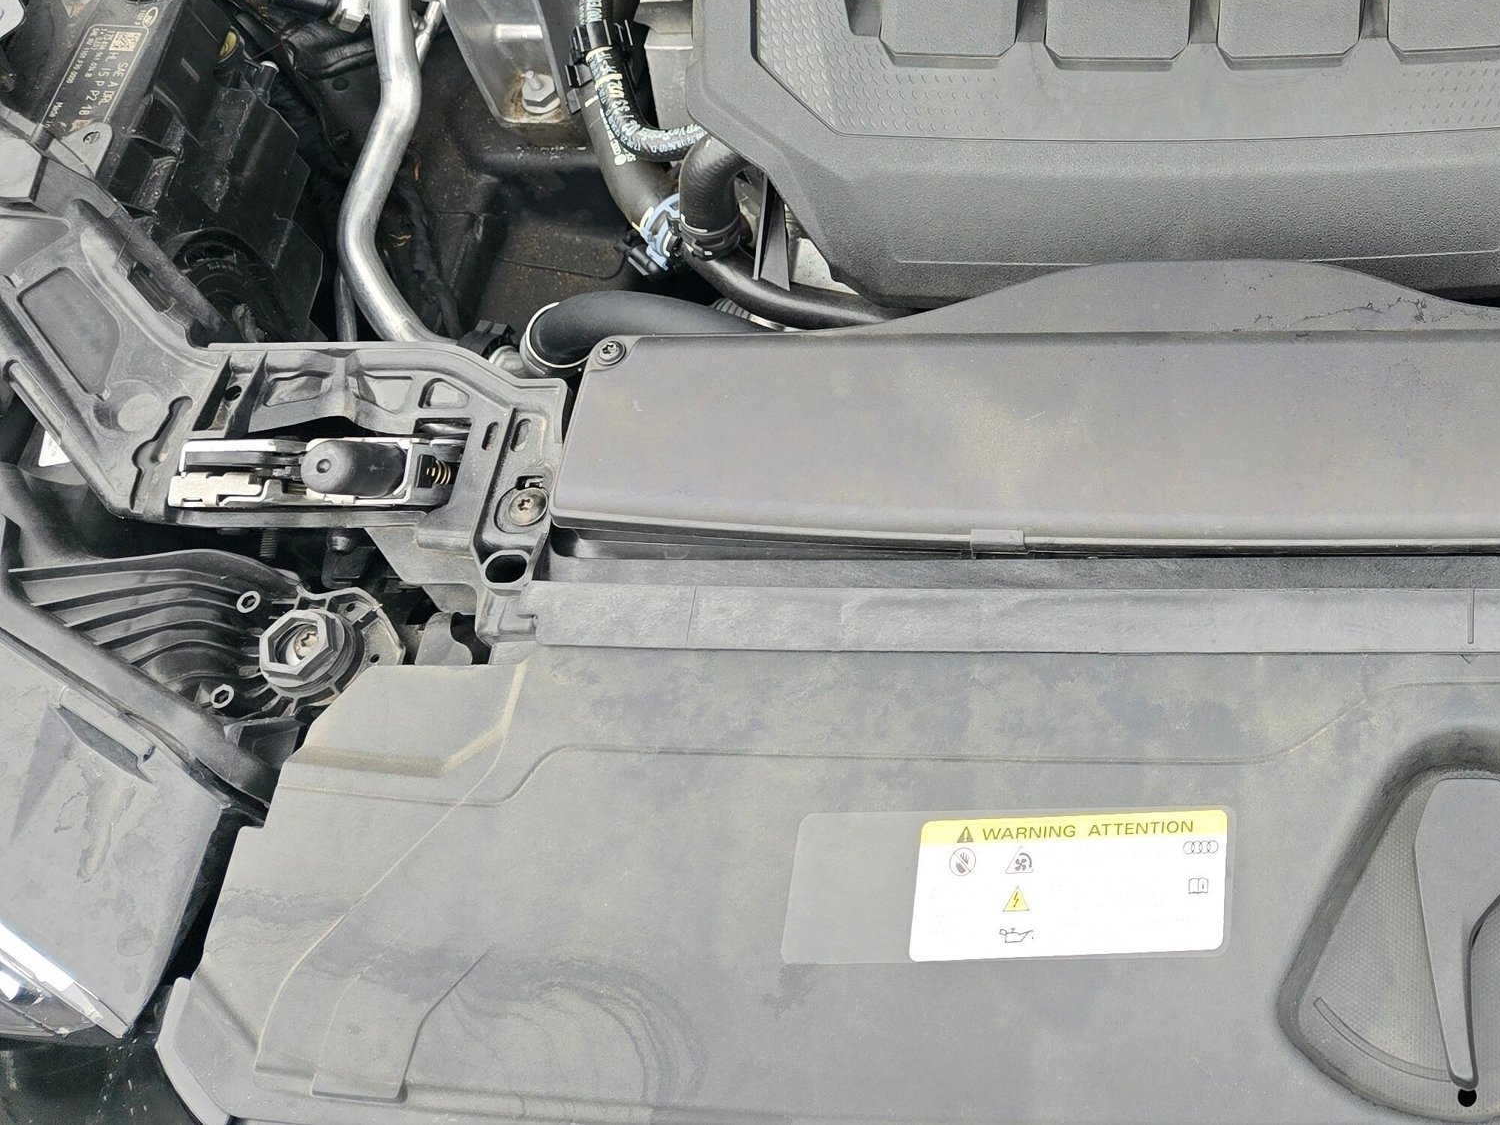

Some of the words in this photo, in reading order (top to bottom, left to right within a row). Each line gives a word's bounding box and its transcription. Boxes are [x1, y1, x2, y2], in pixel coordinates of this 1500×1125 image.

[112, 62, 129, 78] SAE
[107, 80, 119, 88] A
[86, 89, 100, 102] P2
[98, 90, 115, 106] DRL
[982, 824, 1076, 841] WARNING
[1087, 820, 1194, 837] ATTENTION
